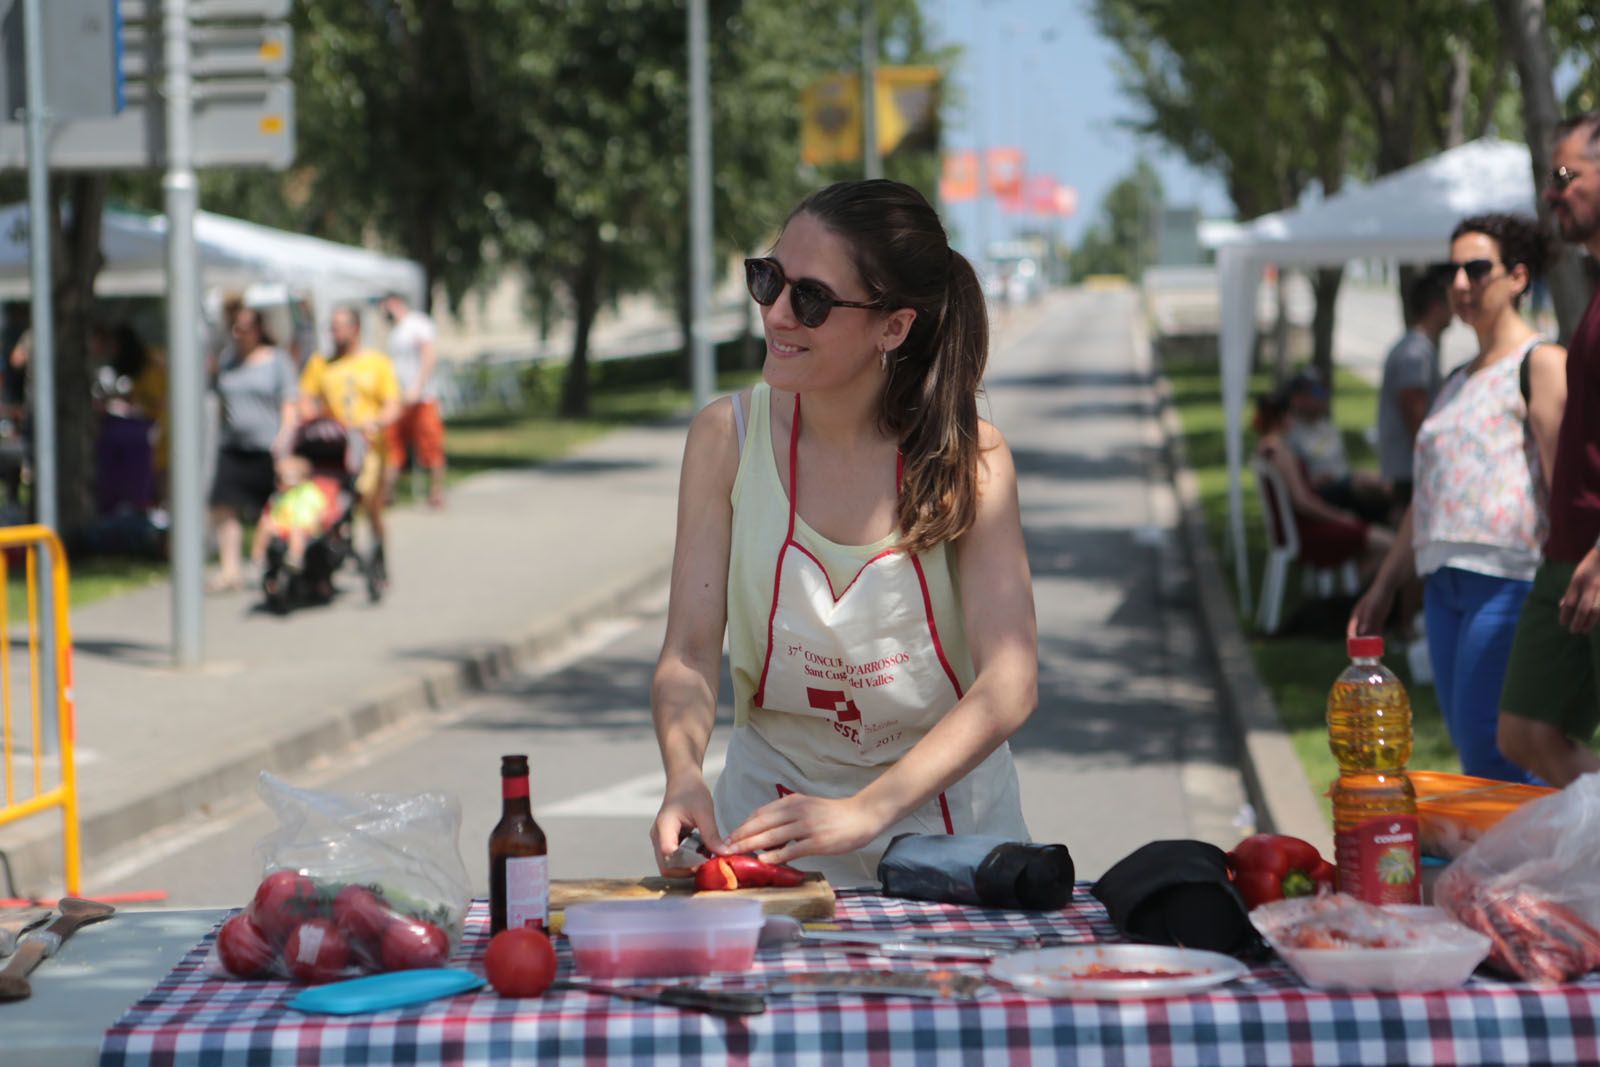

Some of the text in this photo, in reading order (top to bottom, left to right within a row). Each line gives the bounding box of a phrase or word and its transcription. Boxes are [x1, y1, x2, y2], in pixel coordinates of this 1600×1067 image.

[804, 650, 842, 668] CONCU
[846, 652, 910, 675] D'ARROSSOS
[804, 664, 824, 679] Sant
[825, 670, 848, 681] Cug
[876, 731, 902, 748] 2017
